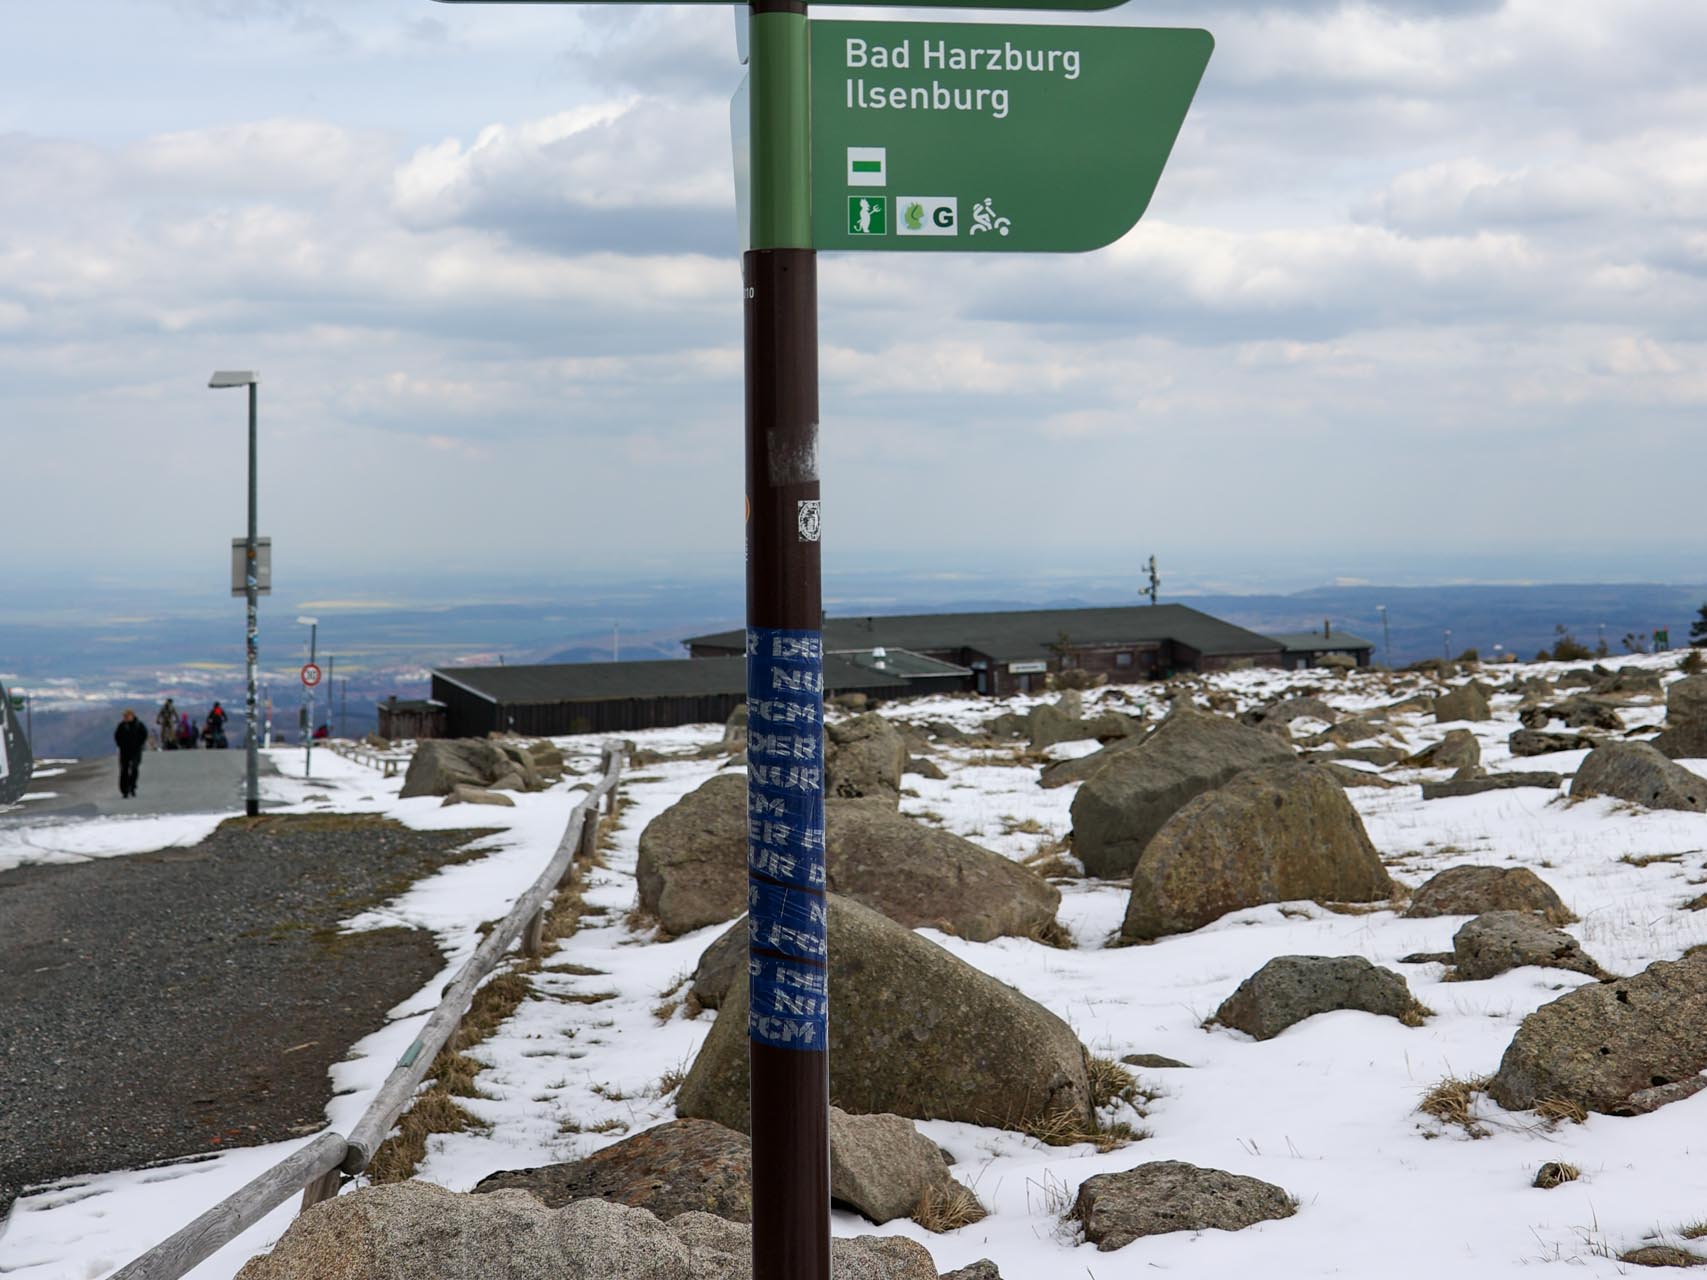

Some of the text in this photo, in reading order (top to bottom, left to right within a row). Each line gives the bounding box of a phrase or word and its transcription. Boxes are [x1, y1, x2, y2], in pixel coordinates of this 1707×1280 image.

[846, 38, 1081, 80] Bad Harzburg
[846, 78, 1009, 119] Ilsenburg
[932, 206, 952, 227] G
